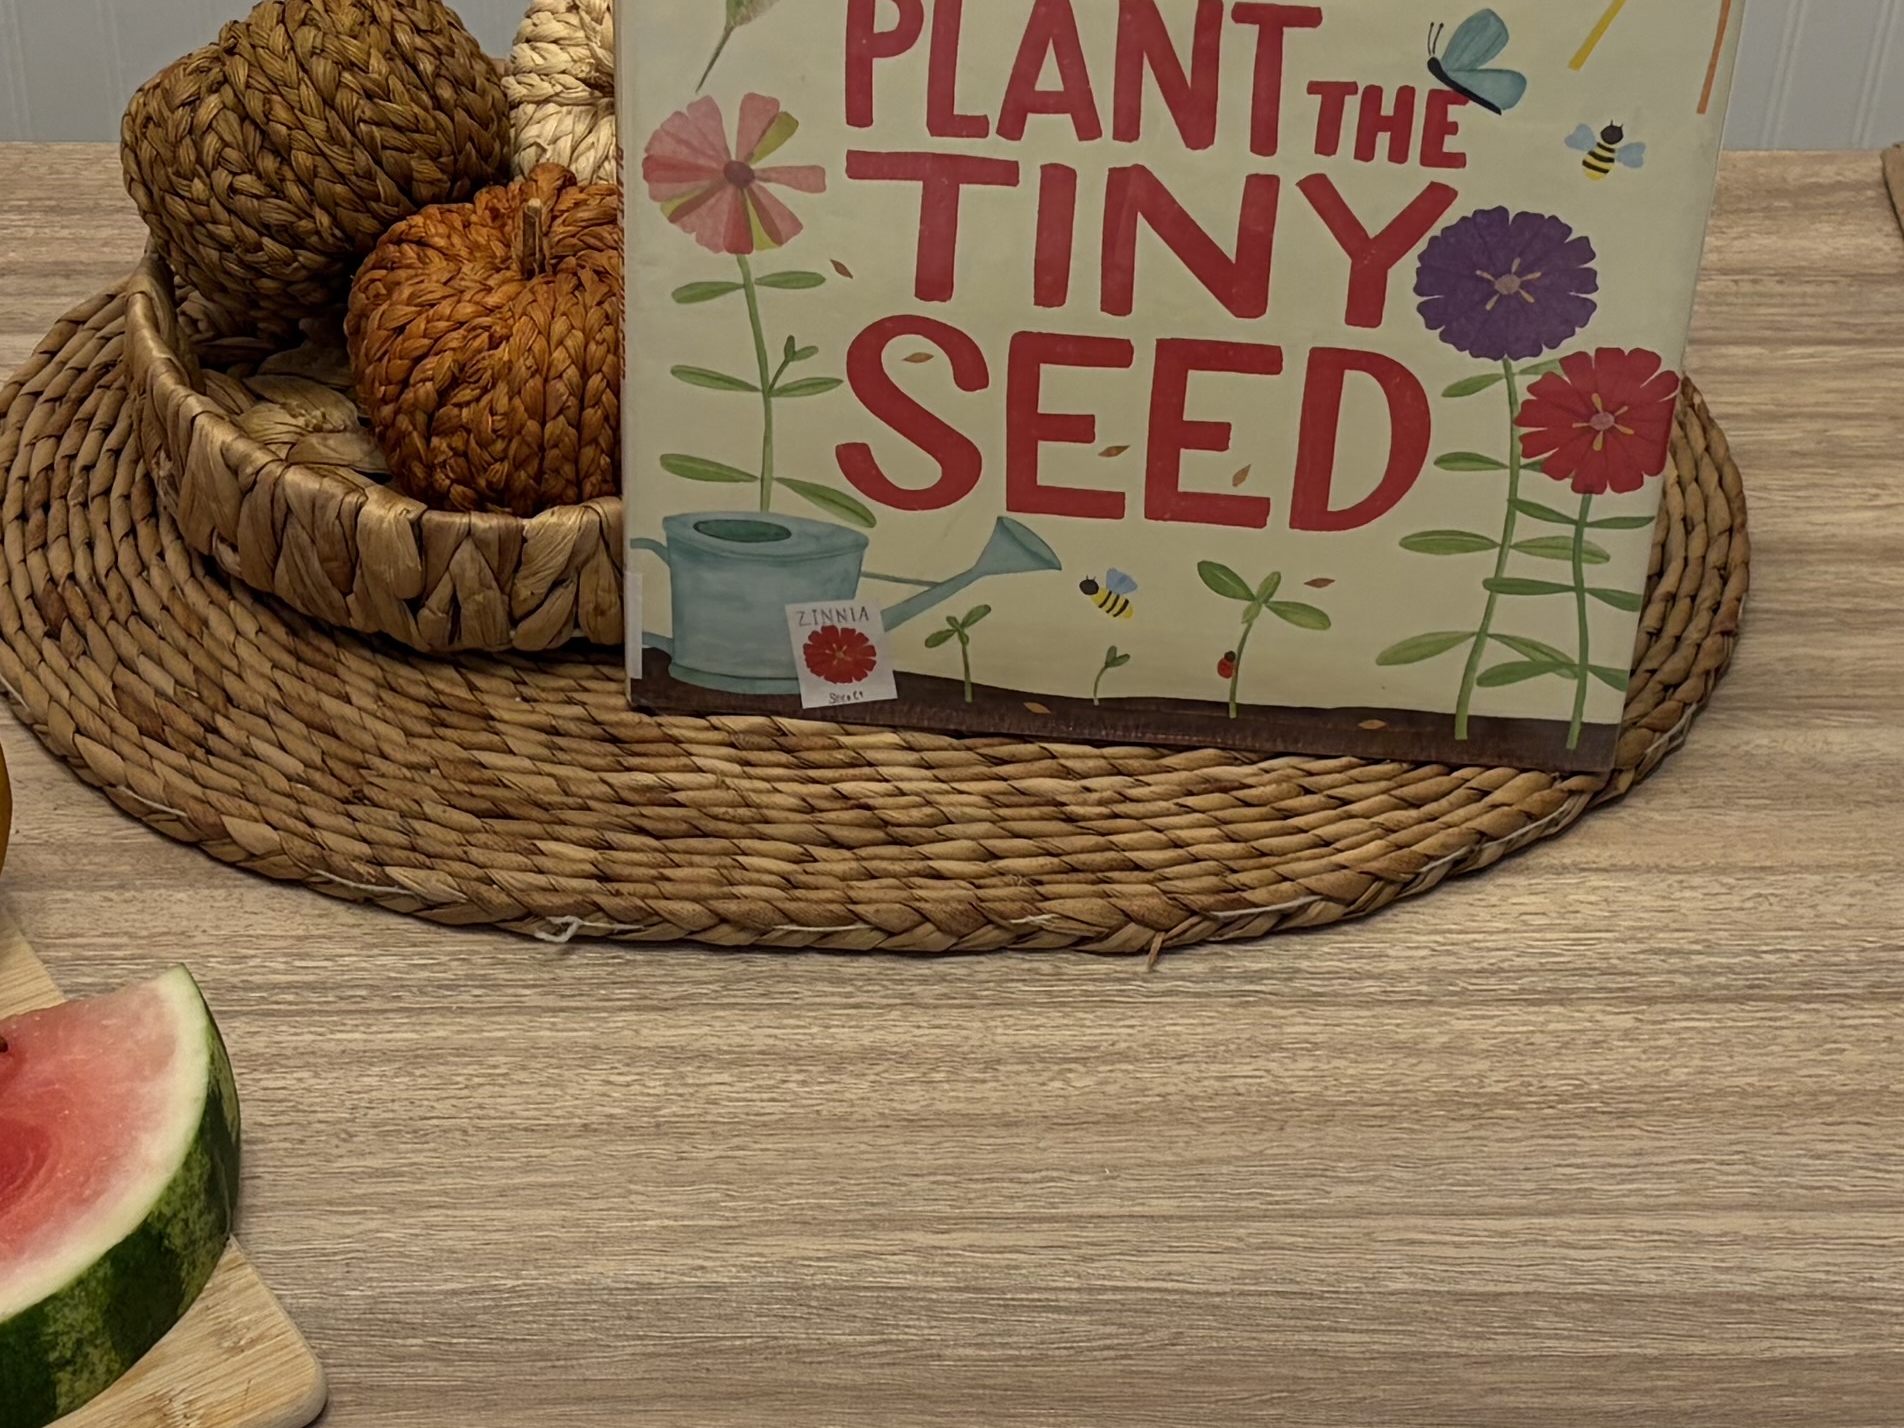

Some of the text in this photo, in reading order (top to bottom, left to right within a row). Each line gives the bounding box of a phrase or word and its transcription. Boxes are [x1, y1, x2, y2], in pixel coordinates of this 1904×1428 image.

[1308, 82, 1469, 169] THE
[846, 152, 1458, 329] TINY
[836, 315, 1432, 532] SEED
[797, 606, 870, 627] ZINNIA
